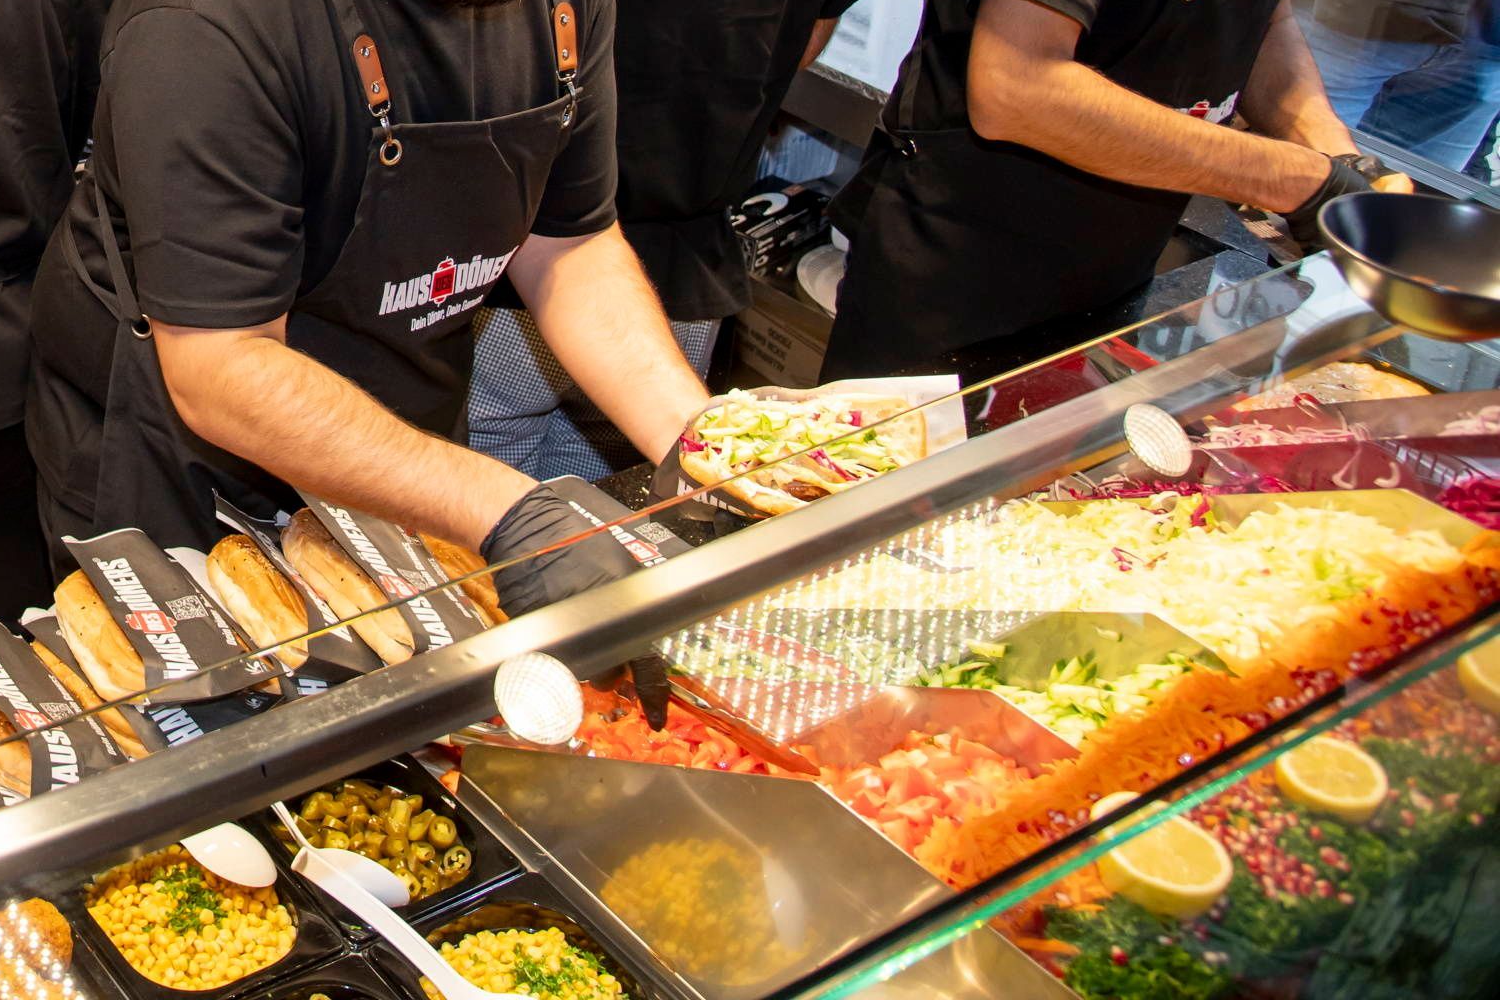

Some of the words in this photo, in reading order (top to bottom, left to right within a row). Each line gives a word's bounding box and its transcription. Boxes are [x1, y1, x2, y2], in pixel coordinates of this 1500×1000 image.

[379, 274, 431, 316] HAUS
[411, 317, 427, 332] Dein
[100, 557, 160, 612] DÖNERS
[145, 632, 200, 680] HAUS
